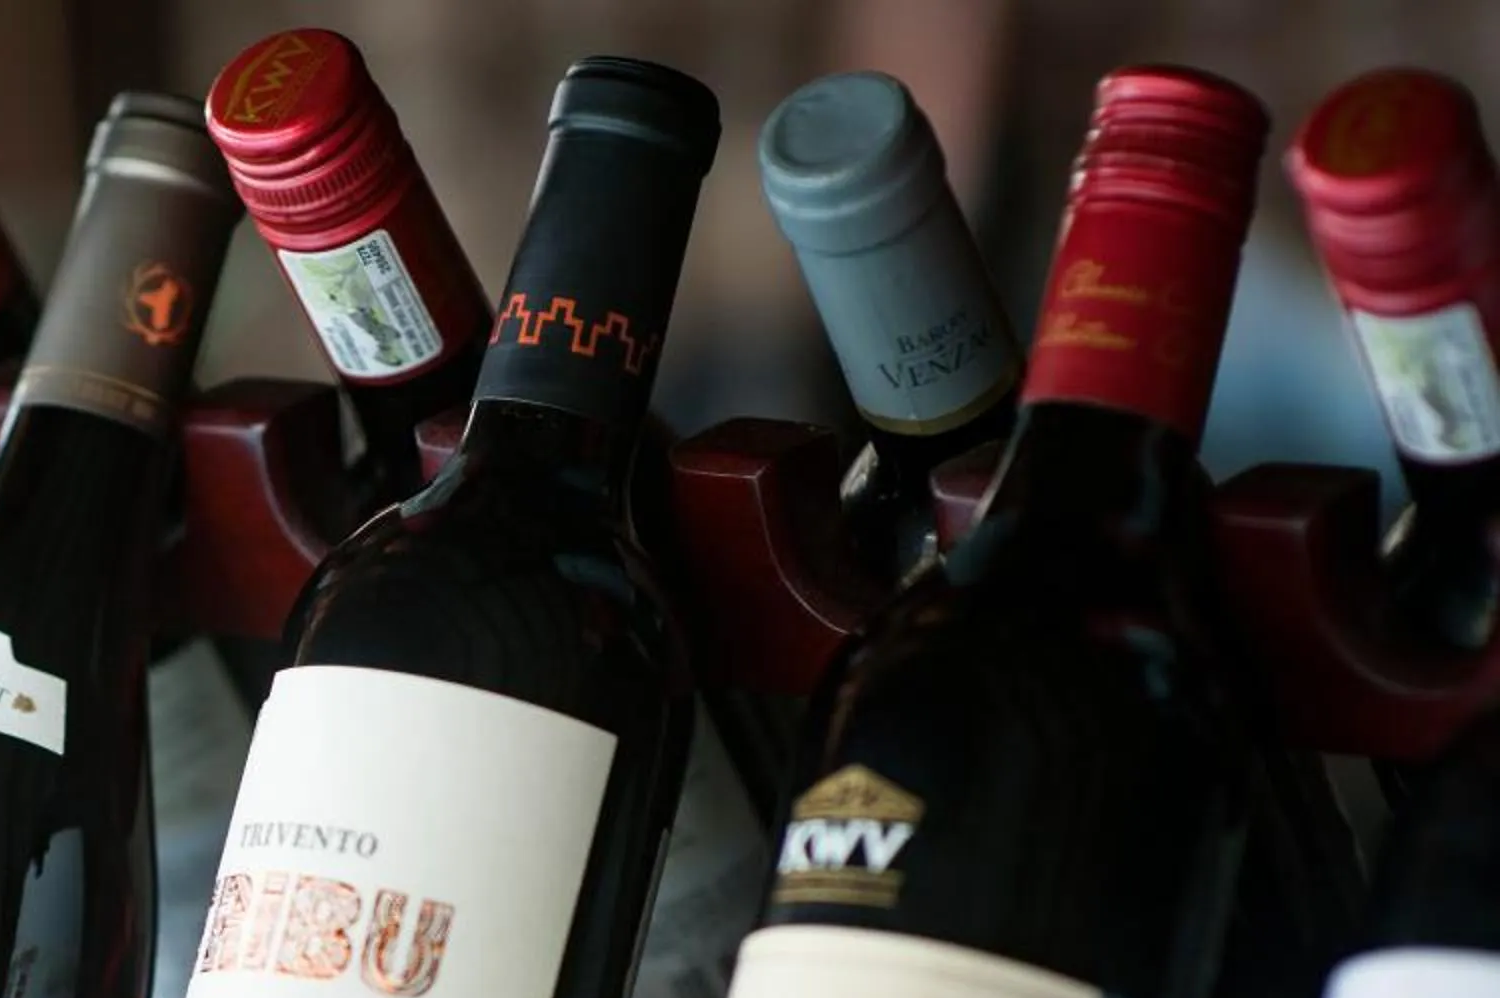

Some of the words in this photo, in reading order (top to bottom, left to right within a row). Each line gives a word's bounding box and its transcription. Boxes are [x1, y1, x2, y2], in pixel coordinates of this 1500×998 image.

[231, 34, 312, 123] KWV
[240, 821, 379, 858] TRIVENTO
[777, 818, 915, 875] KWV
